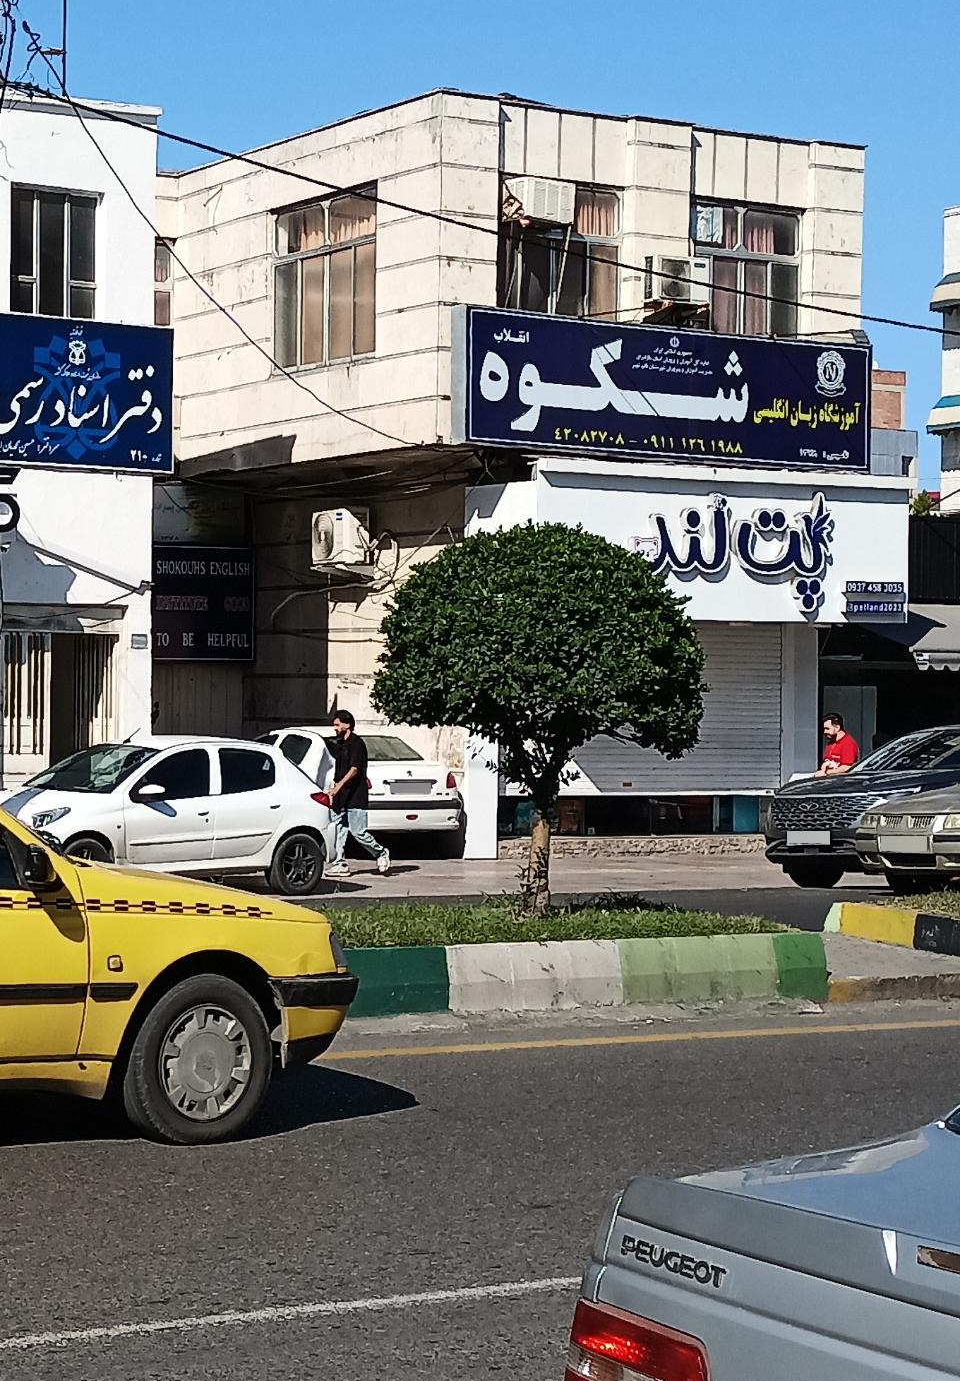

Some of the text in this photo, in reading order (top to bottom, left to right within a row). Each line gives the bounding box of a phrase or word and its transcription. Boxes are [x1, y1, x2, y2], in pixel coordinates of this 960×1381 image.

[493, 328, 530, 344] انقلاب
[49, 384, 110, 428] اسناد
[99, 365, 163, 444] دفتر
[480, 338, 749, 432] شکوه
[753, 398, 861, 431] آموزشگاه زبان انگلیسی
[210, 562, 250, 576] ENGLISH
[737, 492, 833, 611] پت
[156, 632, 249, 648] TO BE HELPFUL
[620, 1234, 727, 1289] PEUGEOT
